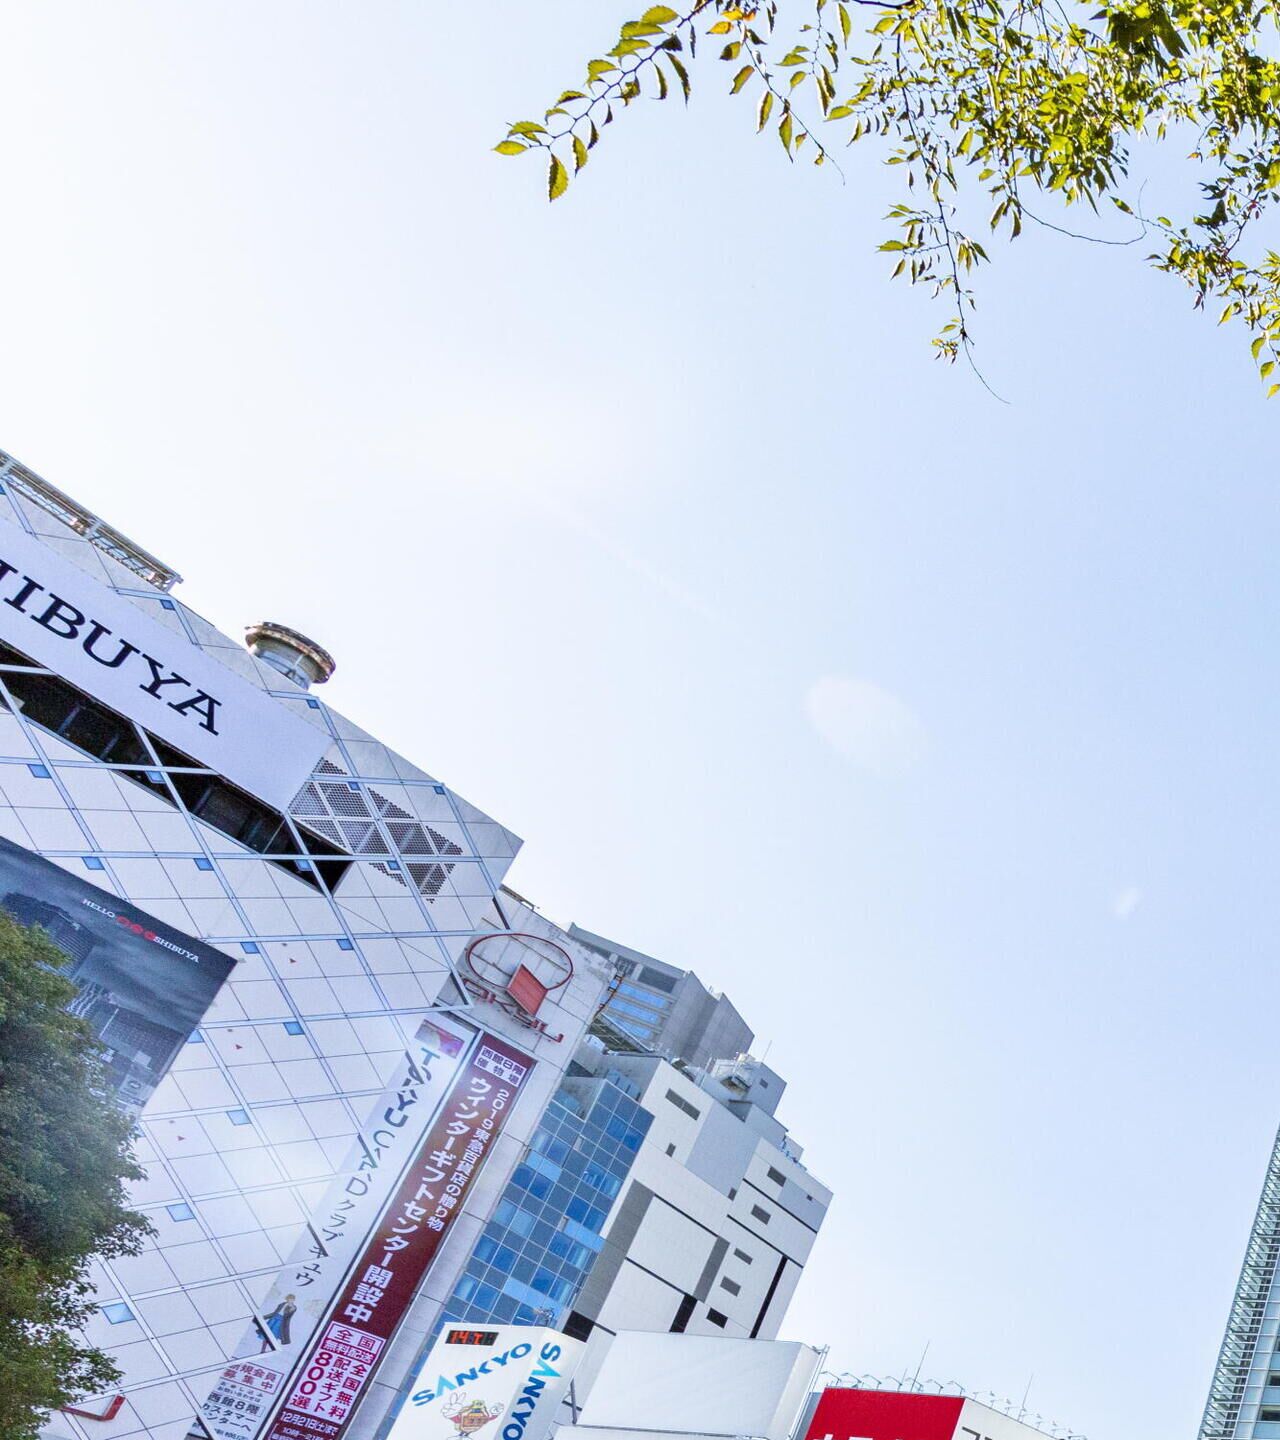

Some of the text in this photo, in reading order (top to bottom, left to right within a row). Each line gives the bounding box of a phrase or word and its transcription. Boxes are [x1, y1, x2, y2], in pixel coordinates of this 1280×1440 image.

[153, 935, 201, 964] SHIBUYA
[290, 1351, 334, 1410] 800選
[412, 1342, 532, 1407] SANKYO
